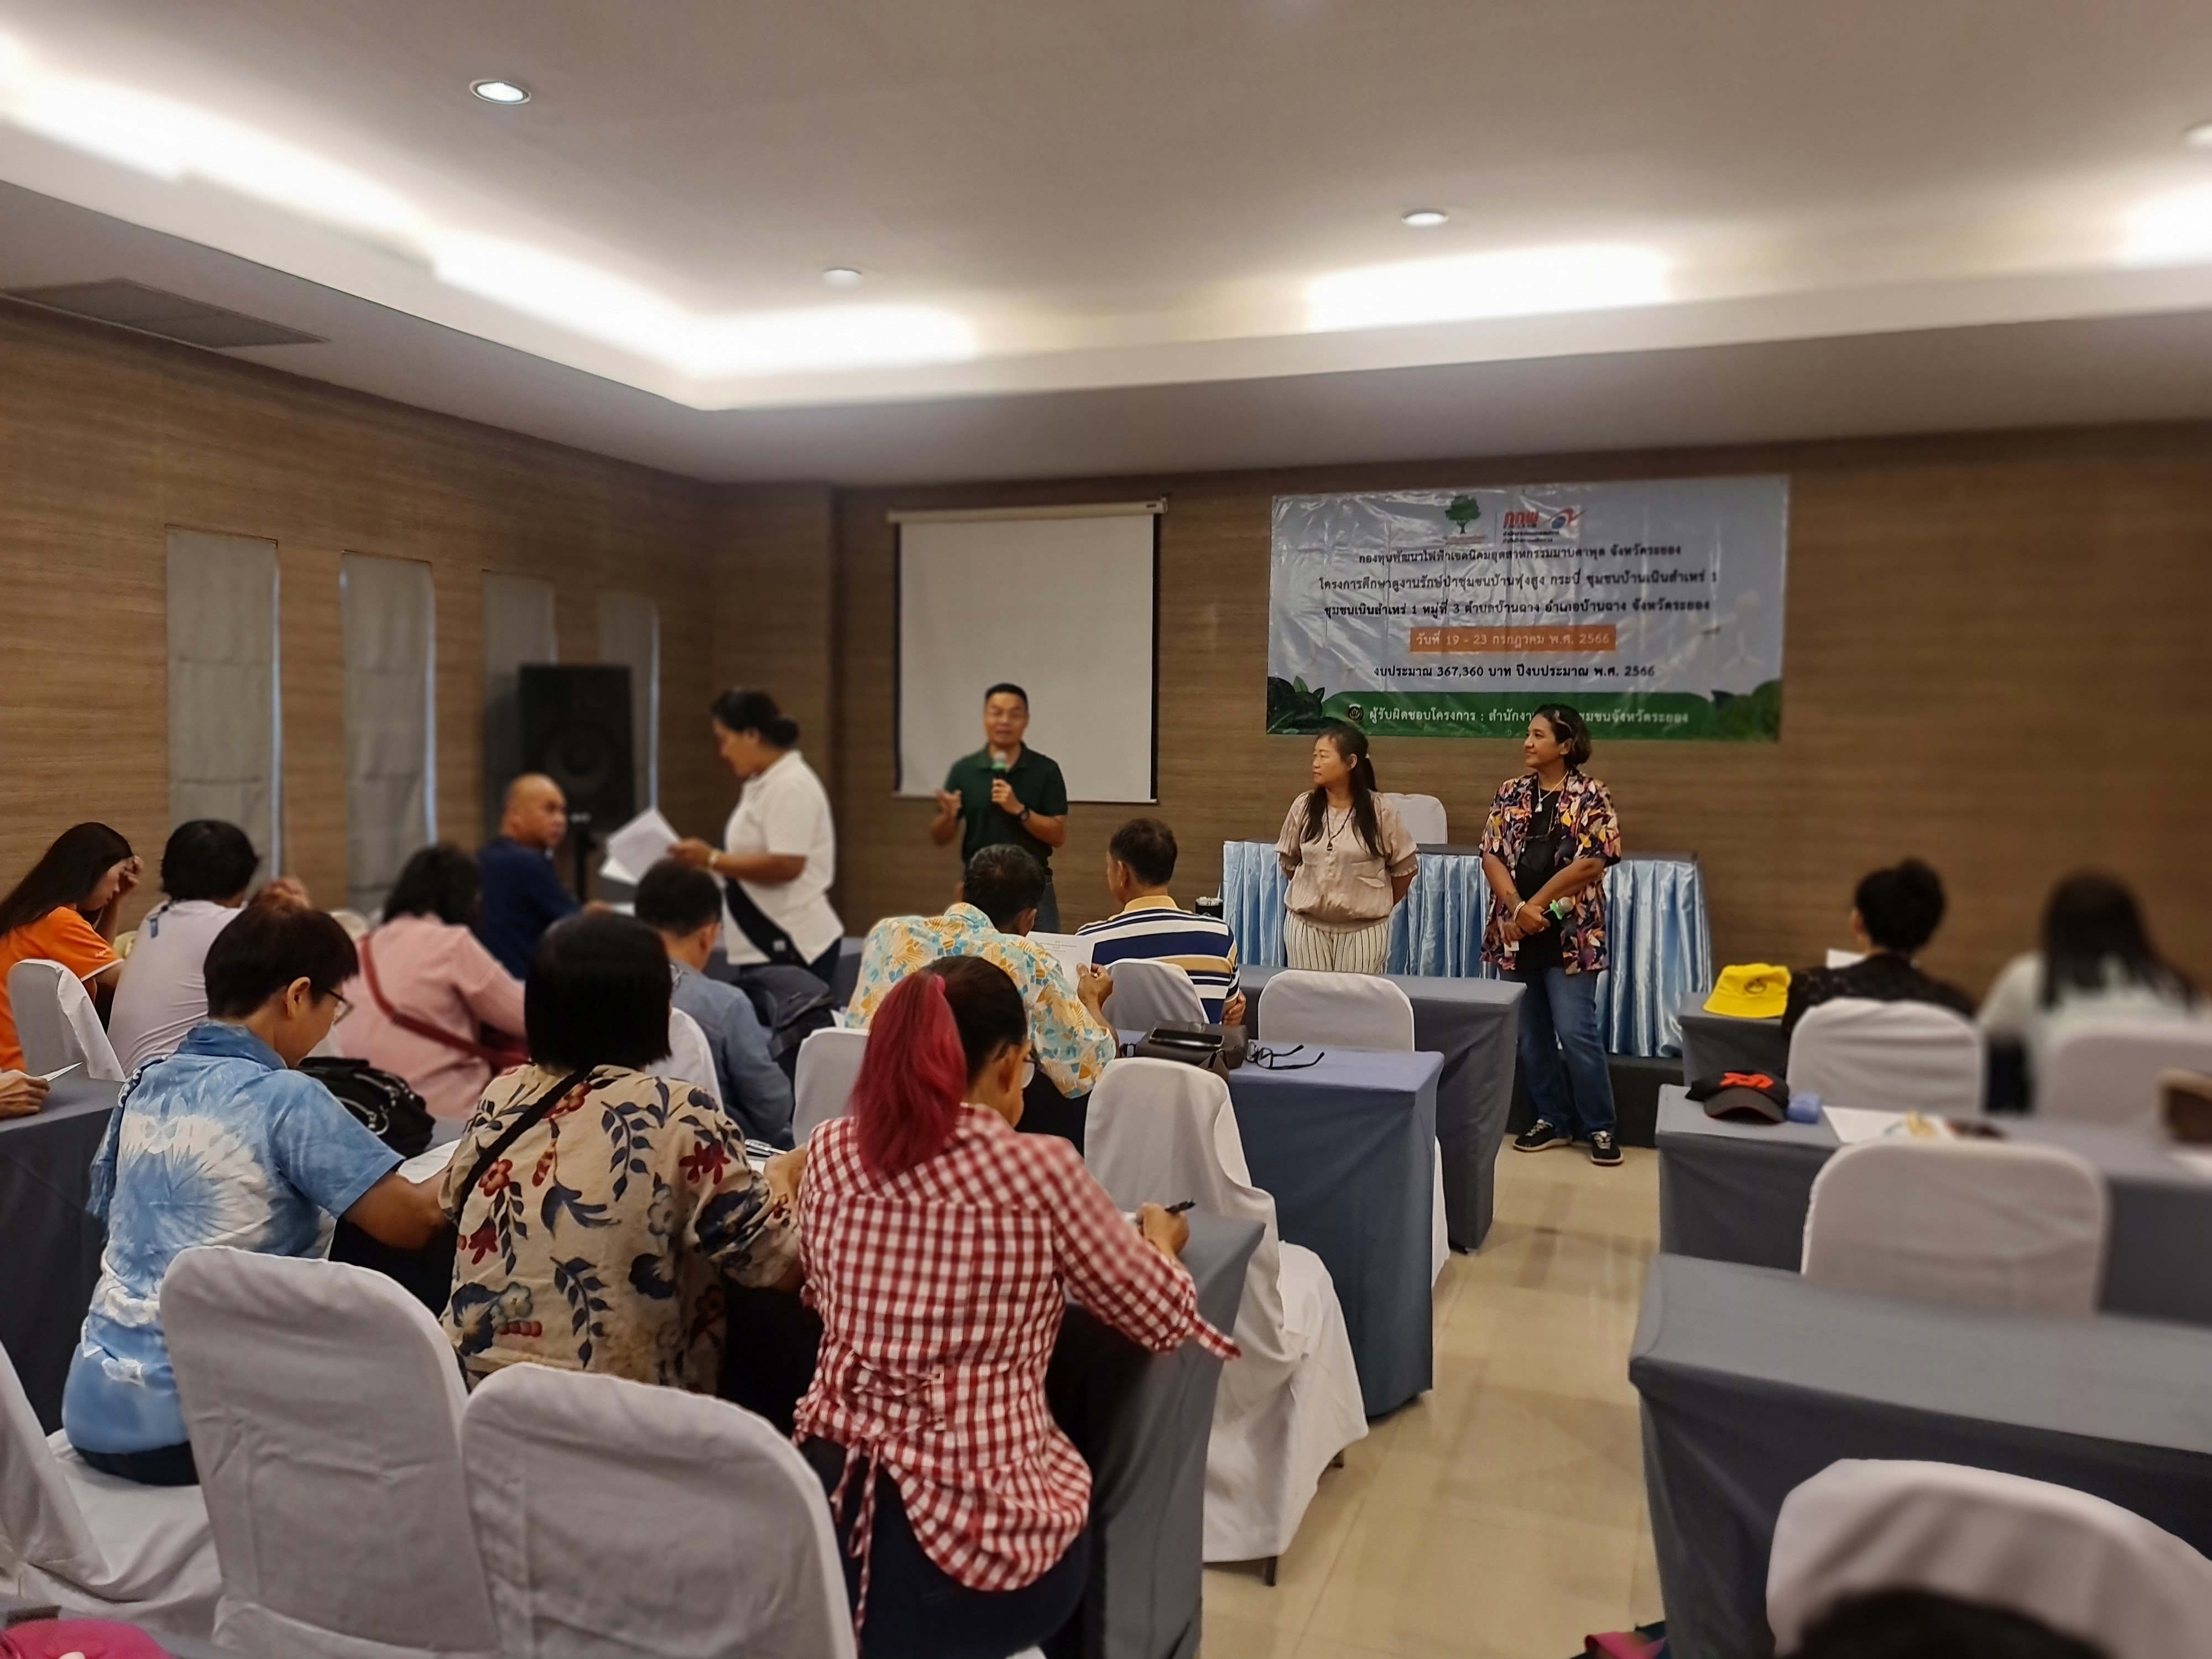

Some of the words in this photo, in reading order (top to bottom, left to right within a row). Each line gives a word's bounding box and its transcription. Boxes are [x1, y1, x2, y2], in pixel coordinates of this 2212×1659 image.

[1550, 568, 1581, 585] กระบี่
[1412, 606, 1417, 614] 1
[1423, 599, 1448, 618] หมู่ที่
[1453, 604, 1460, 614] 3
[1632, 598, 1710, 612] จังหวัดระยอง
[1416, 630, 1440, 645] วันที่
[1446, 635, 1459, 645] 19
[1473, 635, 1487, 645] 23
[1493, 634, 1545, 648] กรกฎาคม
[1550, 634, 1574, 645] พ.ศ.
[1579, 634, 1610, 644] 2566
[1374, 665, 1432, 677] งบประมาณ
[1437, 666, 1484, 678] 367,360
[1489, 666, 1511, 677] บาท
[1516, 664, 1589, 677] ปีงบประมาณ
[1594, 665, 1619, 677] พ.ศ.
[1624, 665, 1655, 677] 2566
[1369, 707, 1476, 723] ผู้รับผิดชอบโครงการ
